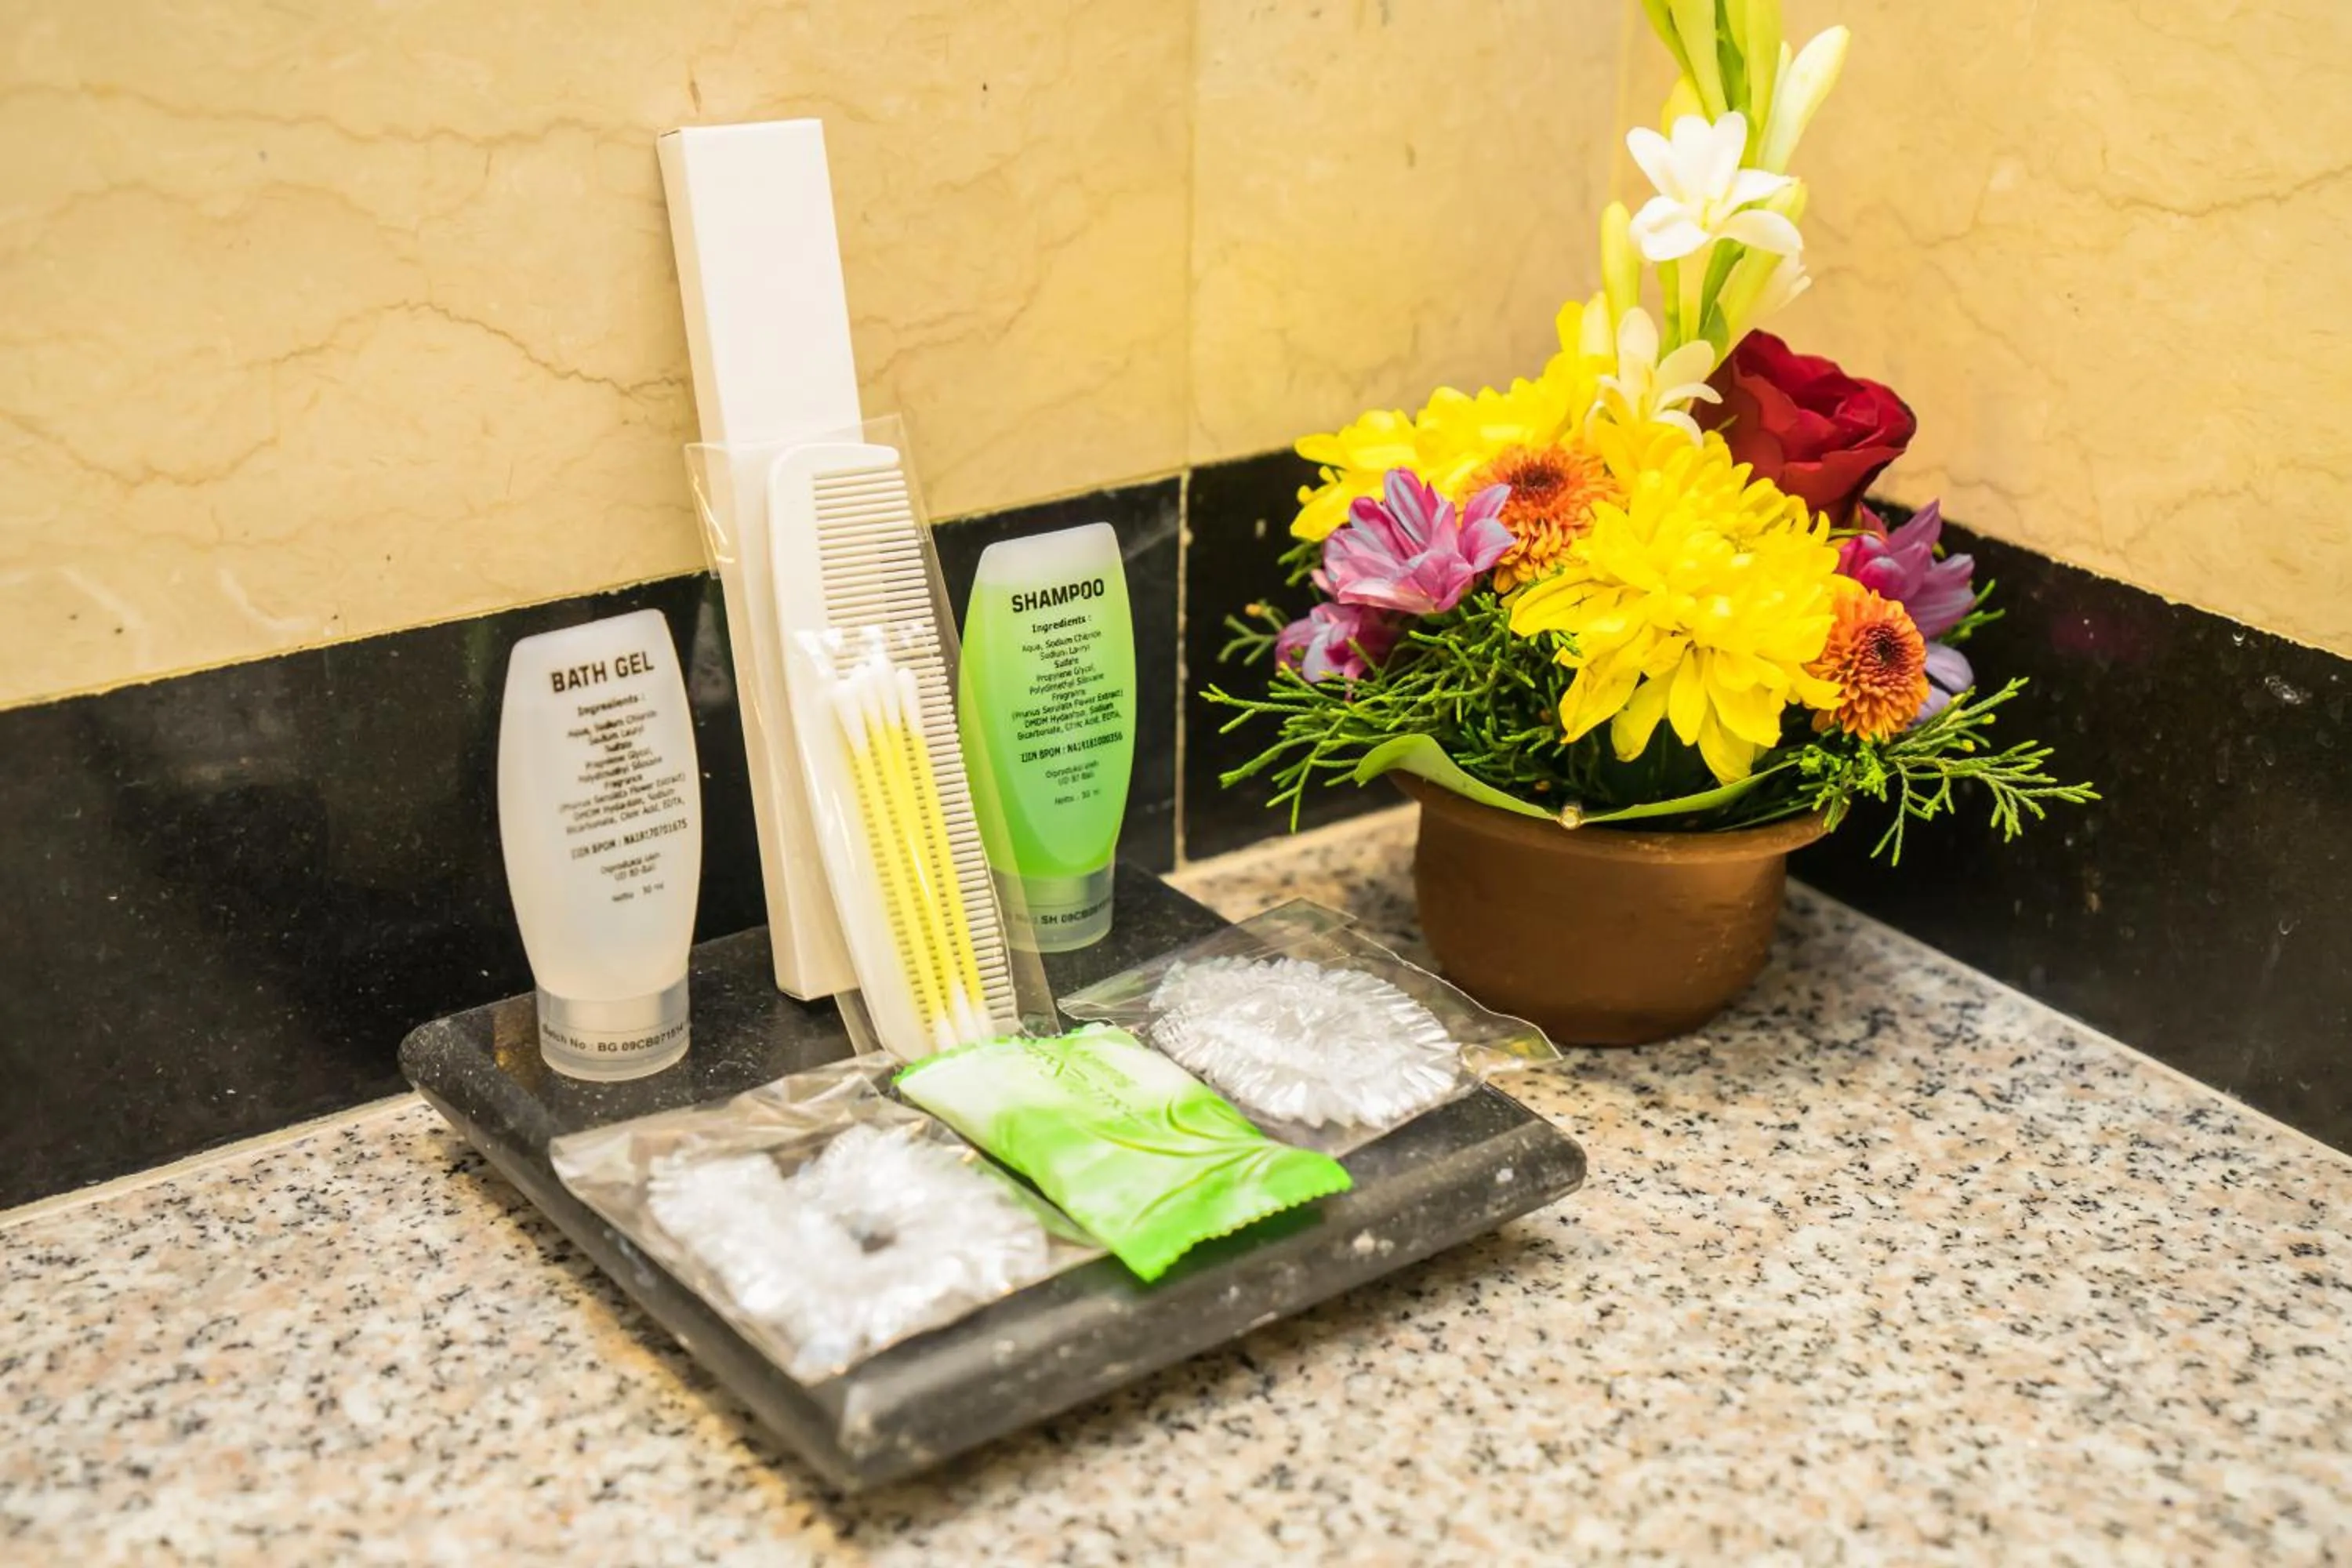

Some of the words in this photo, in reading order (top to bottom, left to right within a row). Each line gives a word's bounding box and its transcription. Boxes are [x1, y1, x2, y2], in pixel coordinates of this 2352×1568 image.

[1011, 579, 1105, 613] SHAMPOO
[1032, 615, 1086, 633] Ingredients
[1045, 637, 1073, 648] Sodium
[550, 660, 608, 693] BATH
[615, 651, 655, 678] GEL
[1039, 746, 1061, 760] BPOM
[1040, 915, 1058, 925] SH
[570, 1036, 586, 1051] No
[597, 1041, 618, 1052] BG
